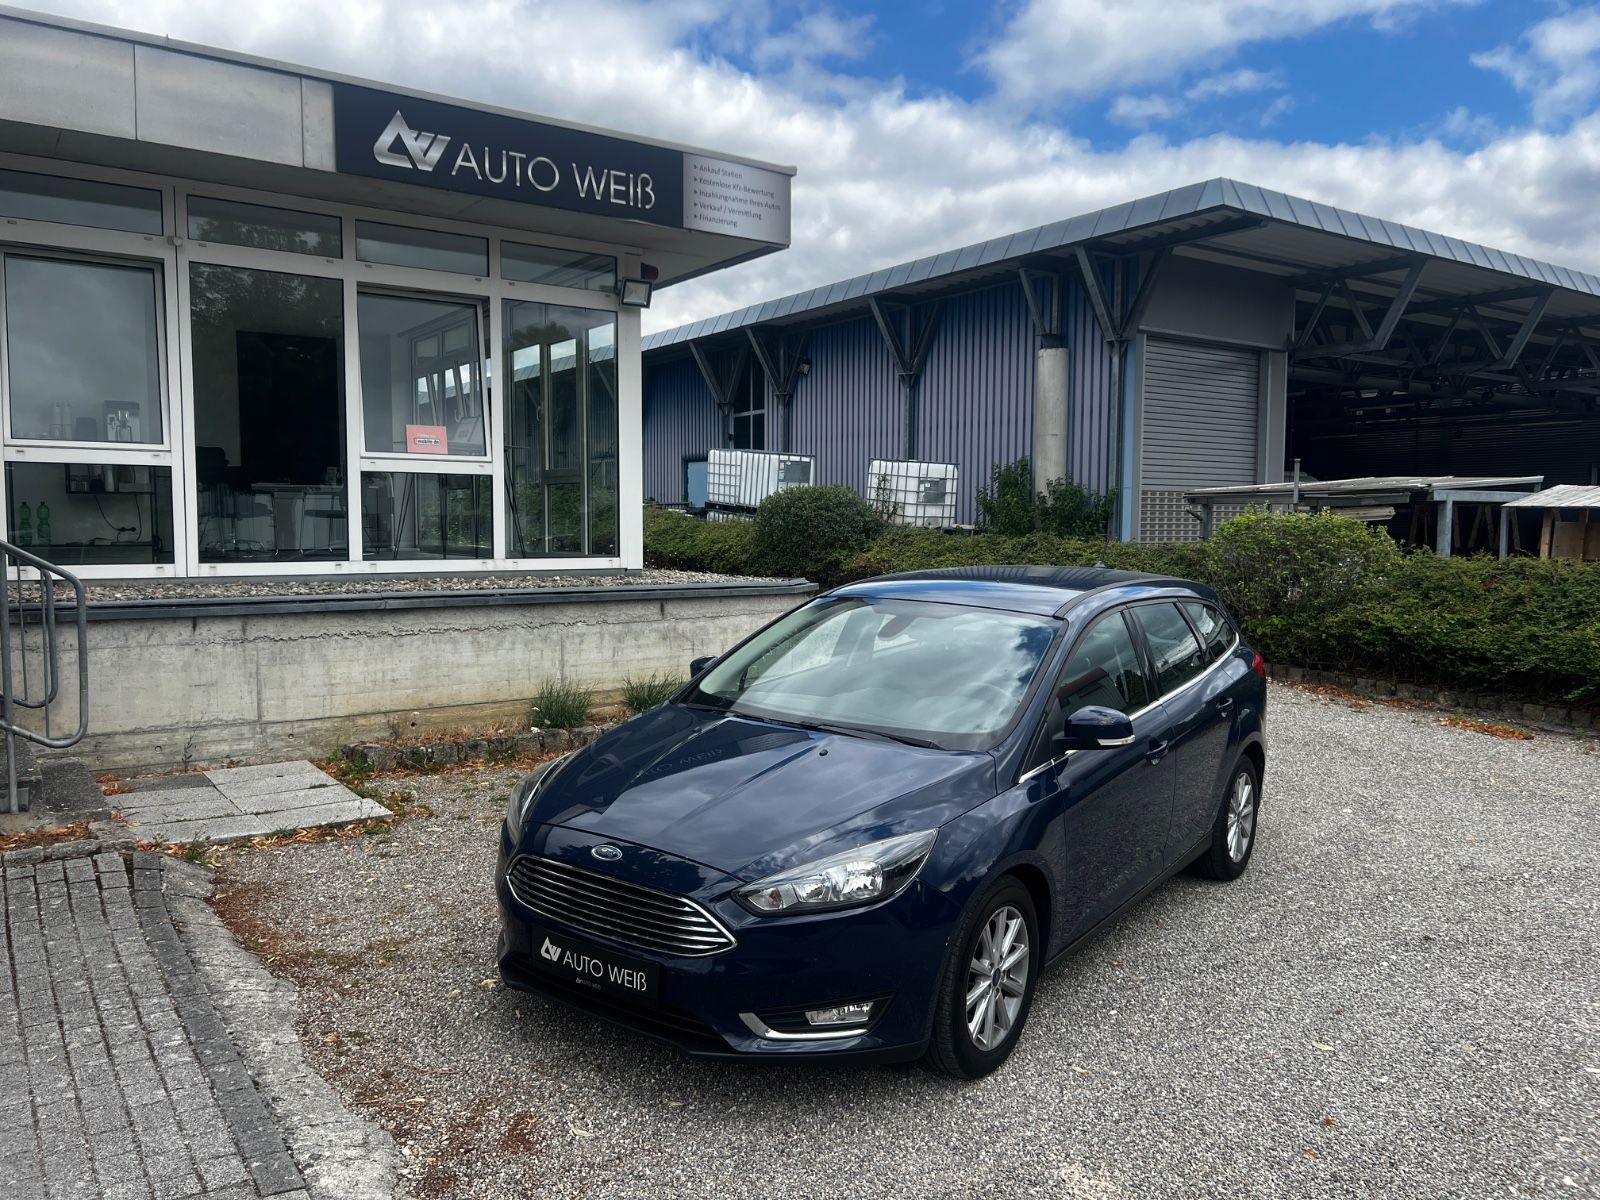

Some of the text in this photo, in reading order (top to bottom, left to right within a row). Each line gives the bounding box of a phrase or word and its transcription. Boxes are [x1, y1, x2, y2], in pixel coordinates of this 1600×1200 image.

[451, 142, 560, 192] AUTO
[572, 162, 656, 209] WEIß
[700, 164, 743, 179] Ankauf Station
[700, 177, 775, 199] Kostenlose Kfz-Bewertung
[699, 201, 723, 213] Verkauf
[749, 199, 764, 208] Ihres
[764, 201, 781, 211] Autos
[700, 213, 738, 229] Finanzierung
[563, 950, 604, 977] AUTO
[608, 963, 647, 992] WEIß
